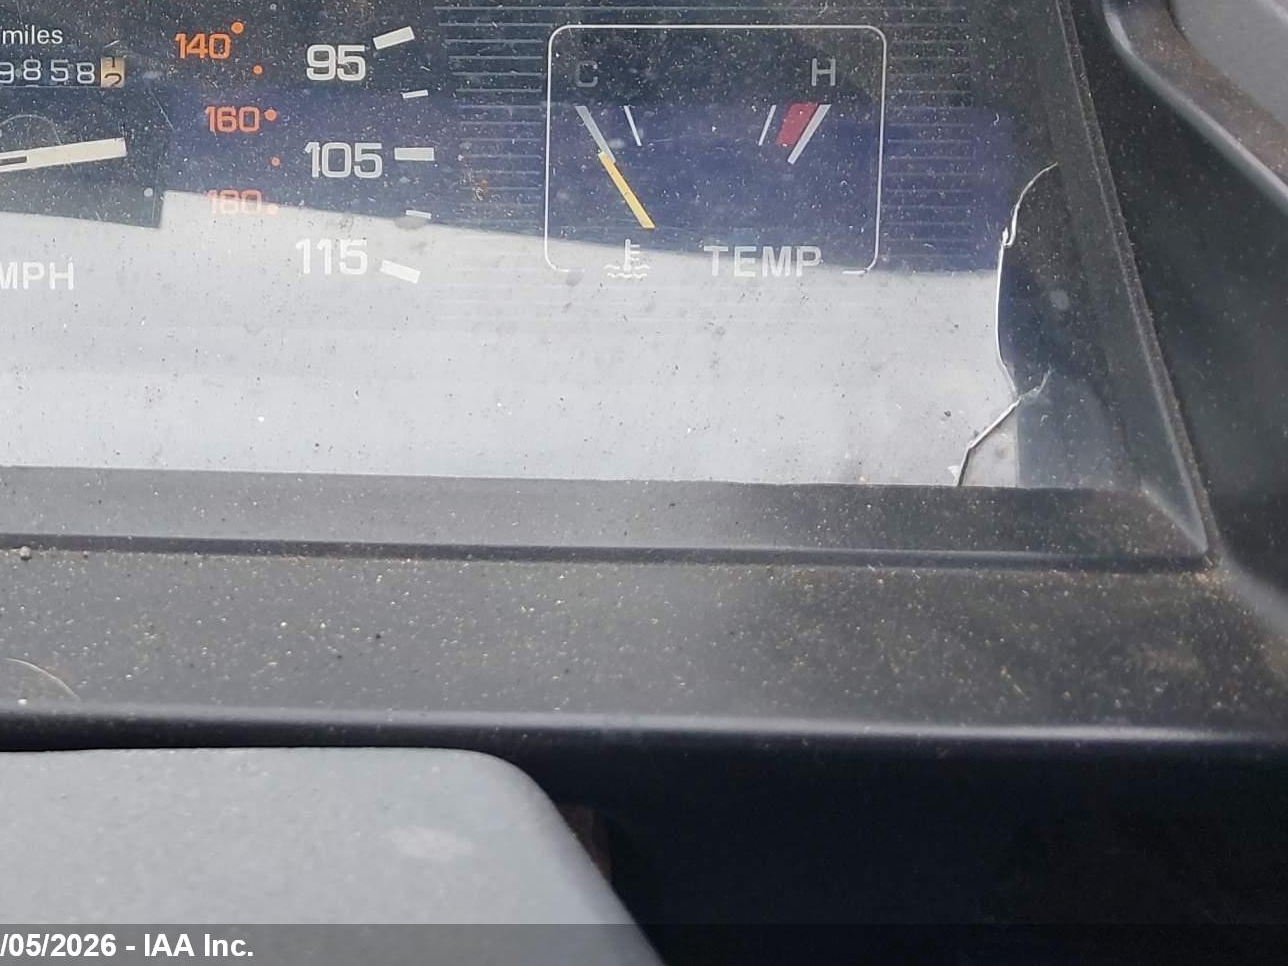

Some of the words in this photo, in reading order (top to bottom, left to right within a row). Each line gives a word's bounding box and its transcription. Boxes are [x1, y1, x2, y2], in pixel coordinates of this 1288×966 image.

[2, 25, 64, 45] miles
[175, 32, 230, 60] 140
[305, 44, 366, 82] 95
[575, 62, 600, 88] C
[811, 59, 837, 87] H
[205, 105, 260, 133] 160
[303, 141, 383, 179] 105
[206, 188, 264, 217] 180
[295, 237, 369, 276] 115
[703, 244, 823, 279] TEMP
